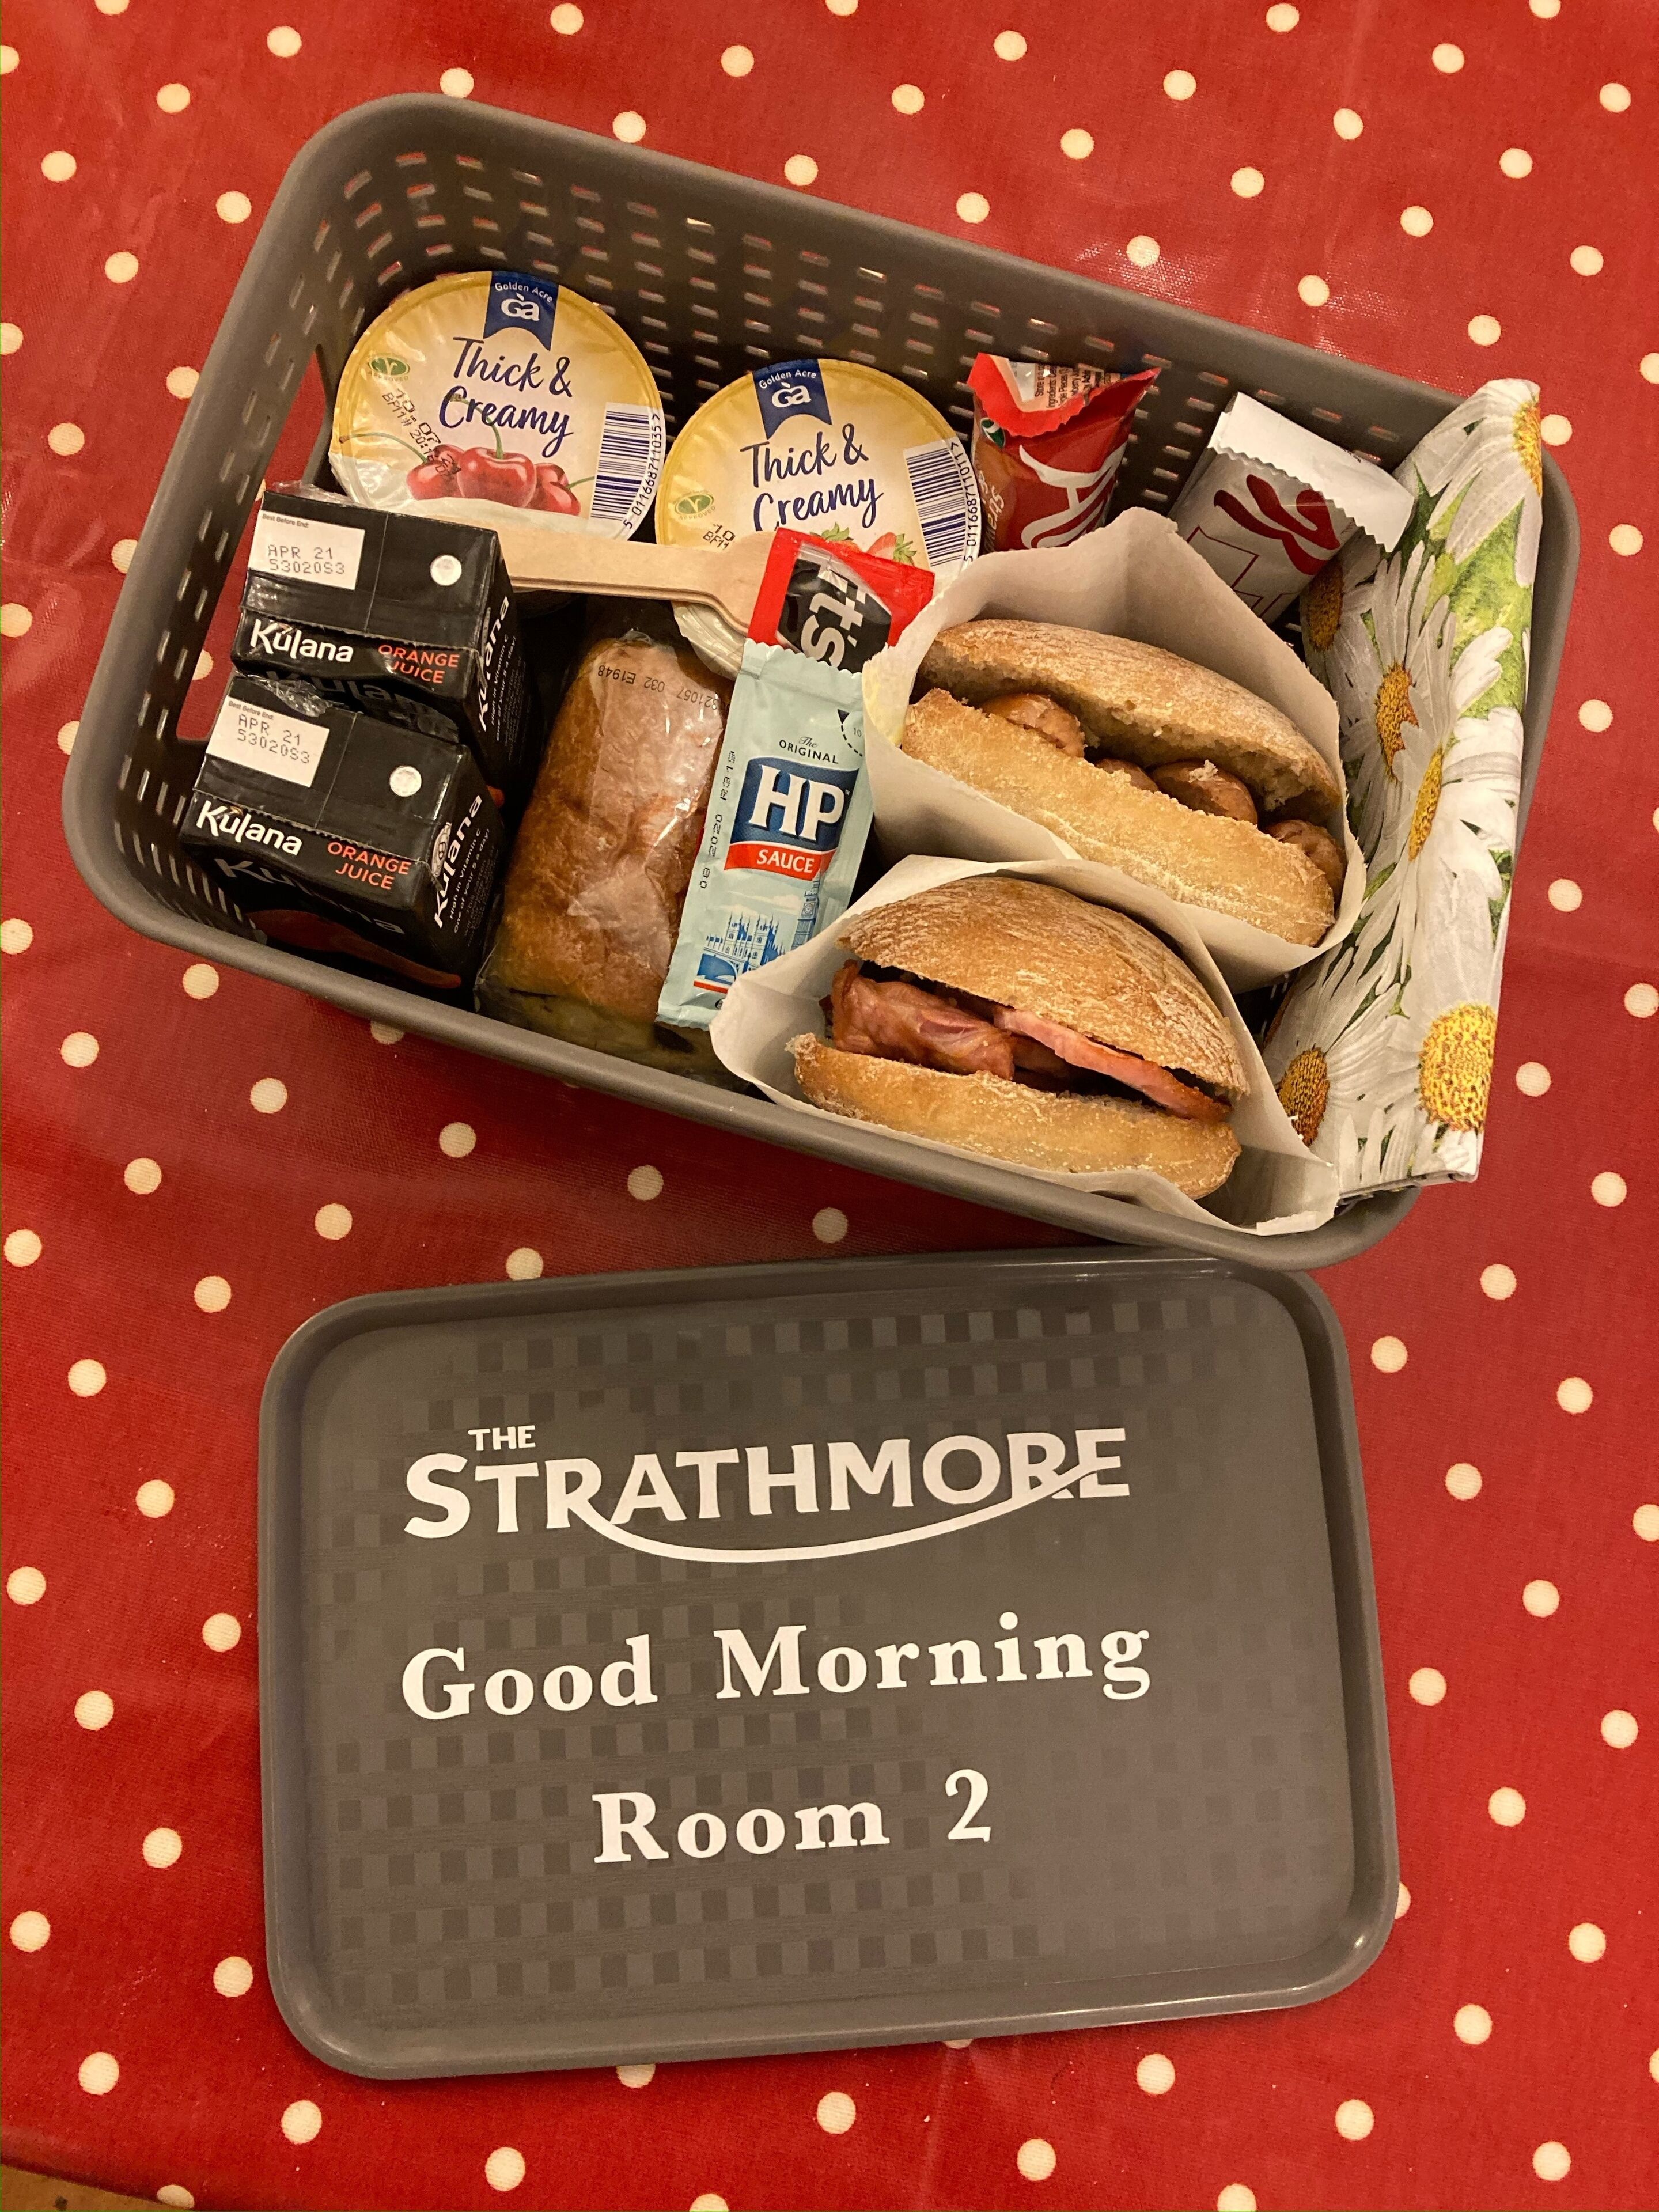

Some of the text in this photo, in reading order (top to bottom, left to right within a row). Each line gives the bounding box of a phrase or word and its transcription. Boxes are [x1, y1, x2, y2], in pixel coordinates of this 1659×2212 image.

[495, 282, 552, 303] Golden Acre
[453, 336, 573, 397] Thick &
[759, 369, 816, 389] Golden Acre
[438, 385, 574, 457] Creamy
[740, 423, 869, 488] Thick &
[753, 476, 884, 531] Creamy
[262, 513, 275, 522] Best
[276, 517, 295, 525] Before
[623, 520, 632, 529] 5
[268, 544, 332, 559] APR 21
[378, 644, 460, 669] ORANGE
[390, 661, 445, 684] JUICE
[597, 665, 636, 684] E1948
[643, 677, 665, 692] 032
[228, 700, 241, 710] Best
[242, 705, 260, 716] Before
[238, 714, 300, 747] APR 21
[798, 736, 818, 748] The
[779, 739, 839, 764] ORIGINAL
[749, 764, 846, 843] HP
[196, 801, 302, 855] Kulana
[327, 842, 412, 875] ORANGE
[435, 795, 482, 929] Kulana
[756, 849, 815, 874] SAUCE
[336, 863, 395, 890] JUICE
[468, 1425, 536, 1452] THE
[404, 1427, 1131, 1563] STRATHMORE
[402, 1612, 1151, 1720] Good Morning
[593, 1768, 992, 1863] Room 2
